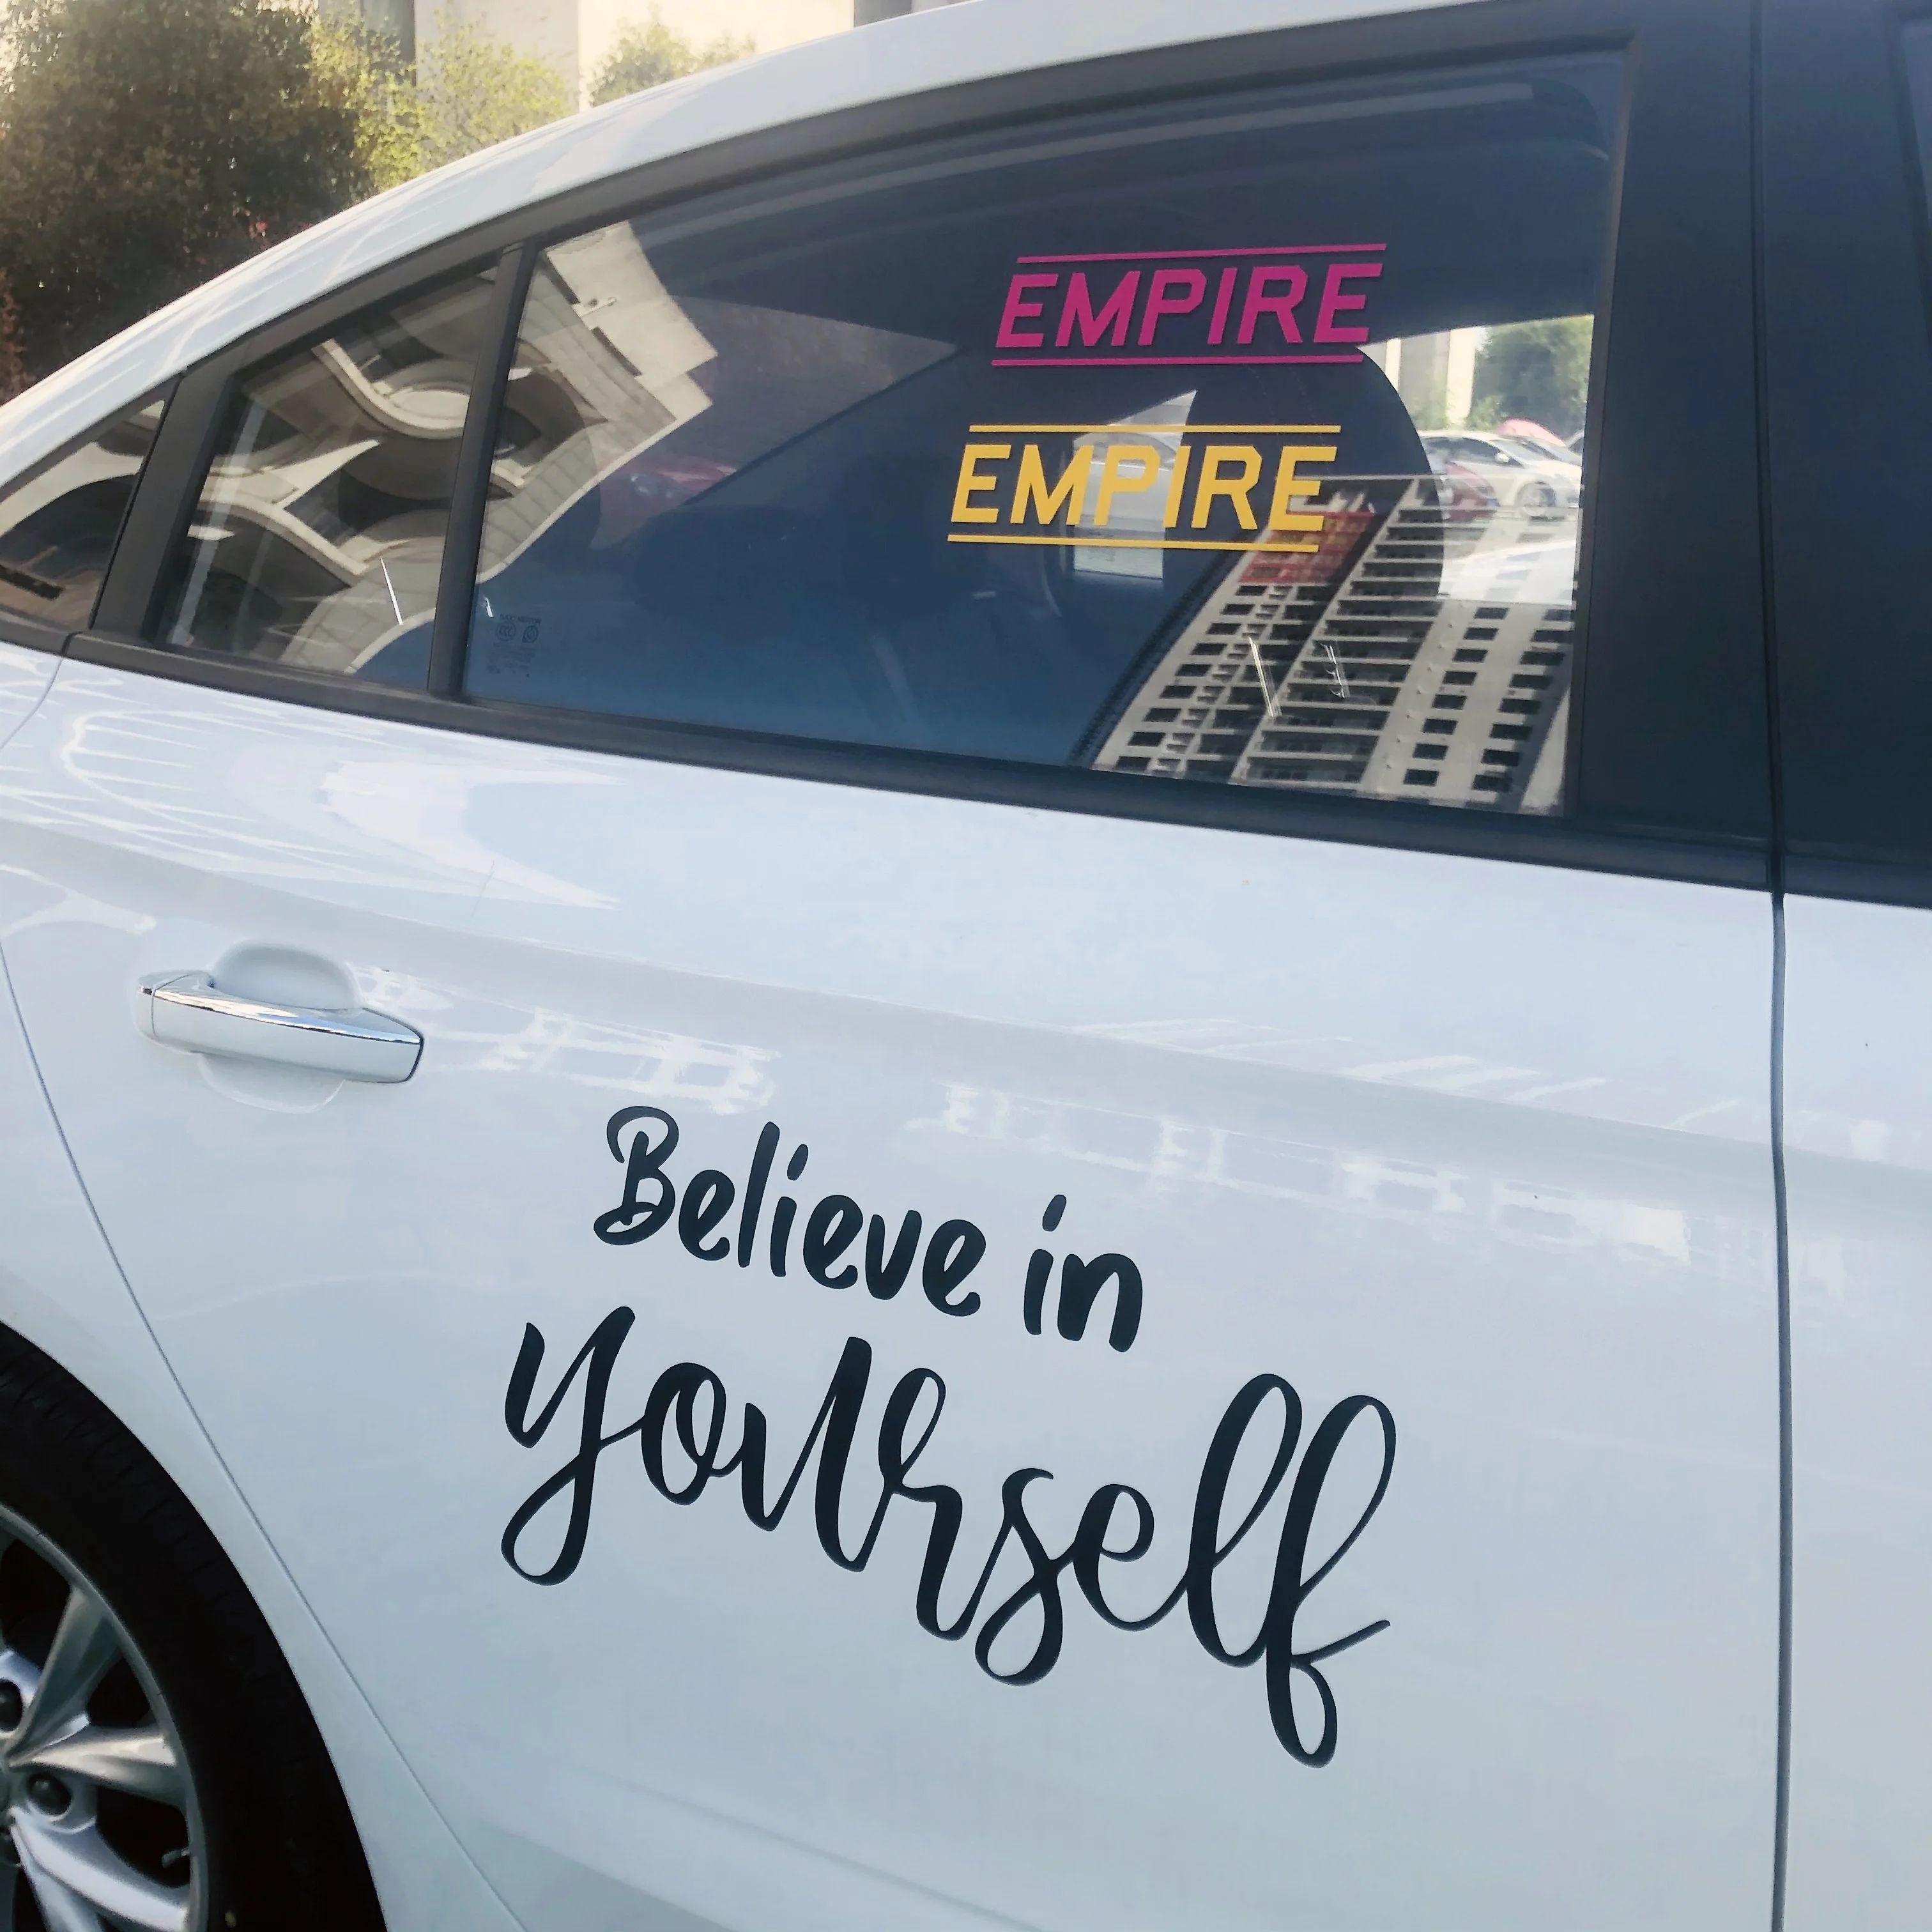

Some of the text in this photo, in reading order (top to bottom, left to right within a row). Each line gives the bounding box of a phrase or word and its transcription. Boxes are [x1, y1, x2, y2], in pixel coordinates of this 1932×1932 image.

[996, 264, 1383, 348] EMPIRE
[951, 445, 1337, 531] EMPIRE
[594, 1105, 1143, 1353] Believe in
[502, 1307, 1397, 1768] yourself
